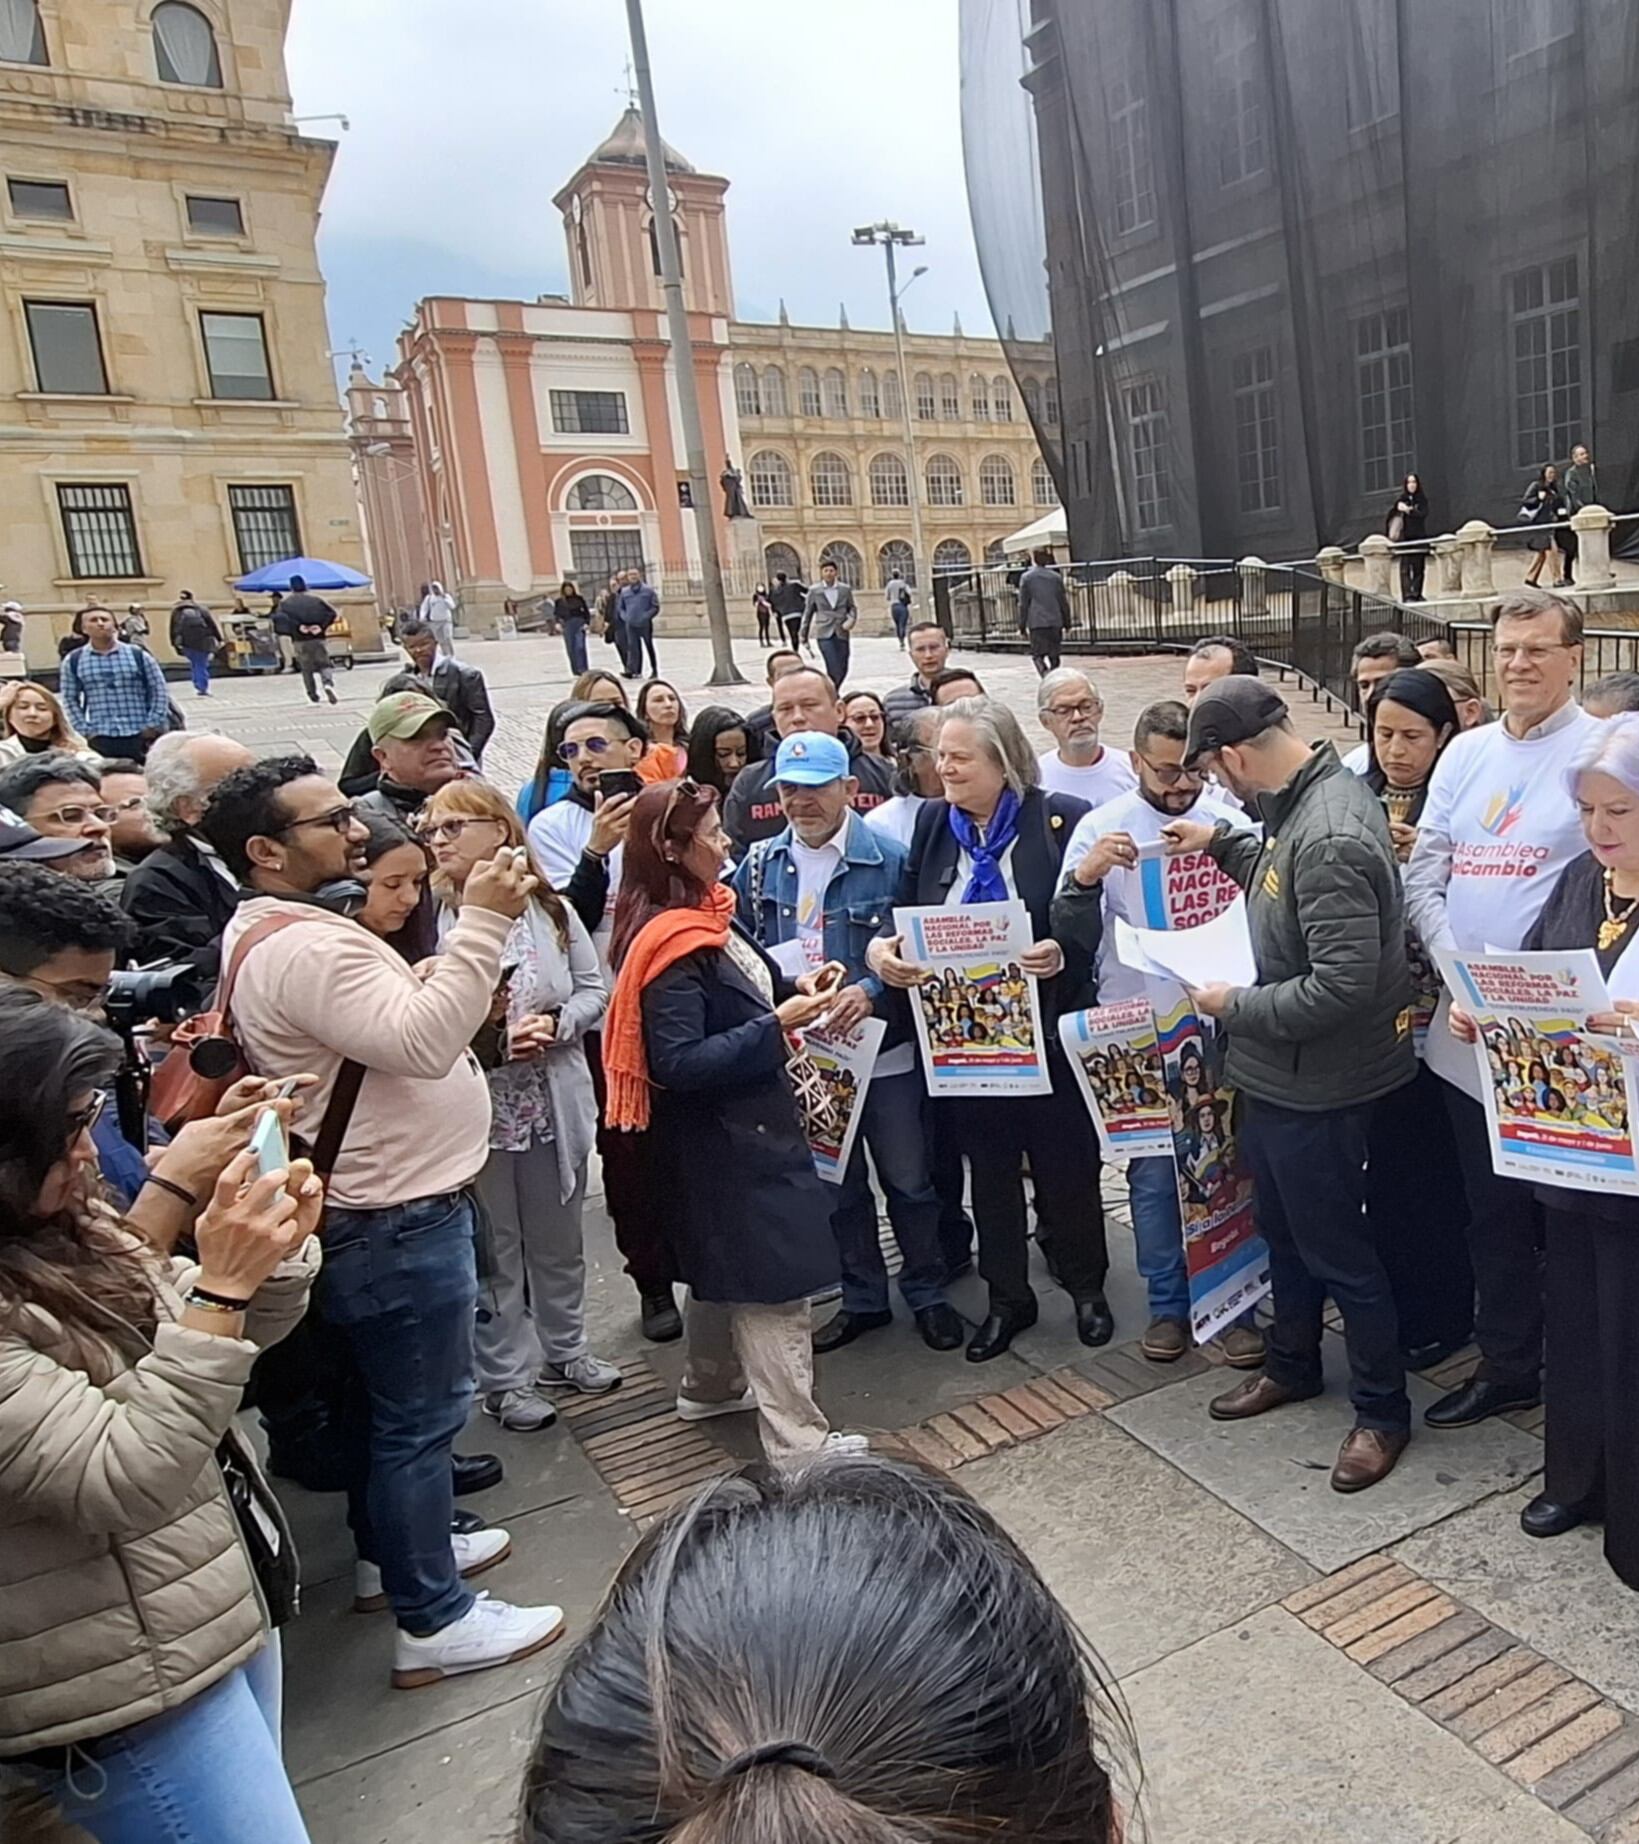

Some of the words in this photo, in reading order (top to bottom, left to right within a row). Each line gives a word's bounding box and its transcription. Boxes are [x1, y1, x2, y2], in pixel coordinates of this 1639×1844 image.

[1171, 891, 1210, 914] LAS
[1215, 885, 1238, 904] RE
[1467, 963, 1525, 973] ASAMBLEA
[1470, 971, 1526, 980] NACIONAL
[1498, 980, 1559, 989] REFORMAS
[1537, 989, 1552, 997] LA
